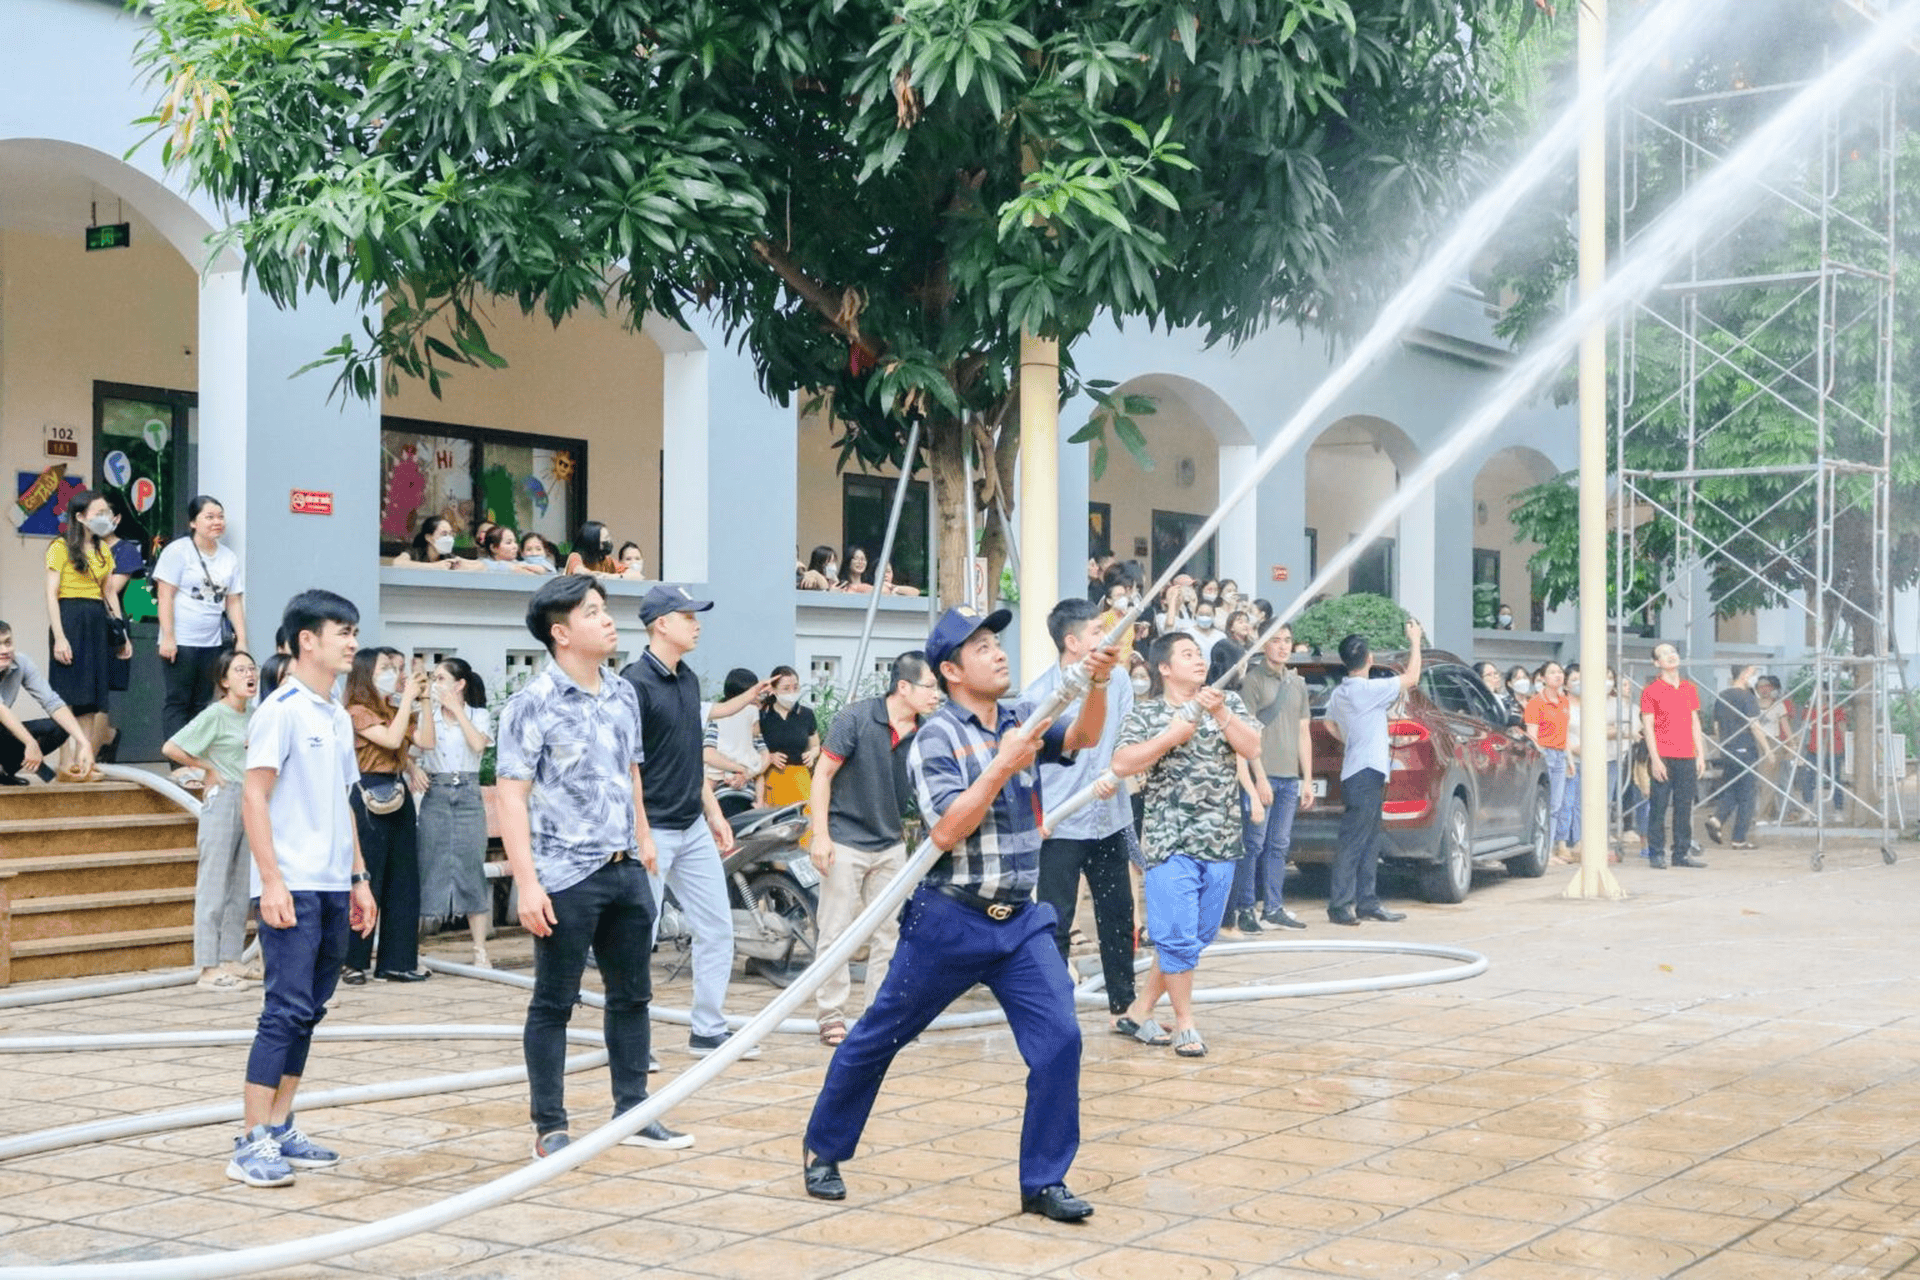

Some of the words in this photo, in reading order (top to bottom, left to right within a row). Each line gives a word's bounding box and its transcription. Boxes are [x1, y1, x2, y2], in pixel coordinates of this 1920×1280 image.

[52, 427, 74, 440] 102
[108, 452, 125, 485] F
[137, 479, 153, 511] P
